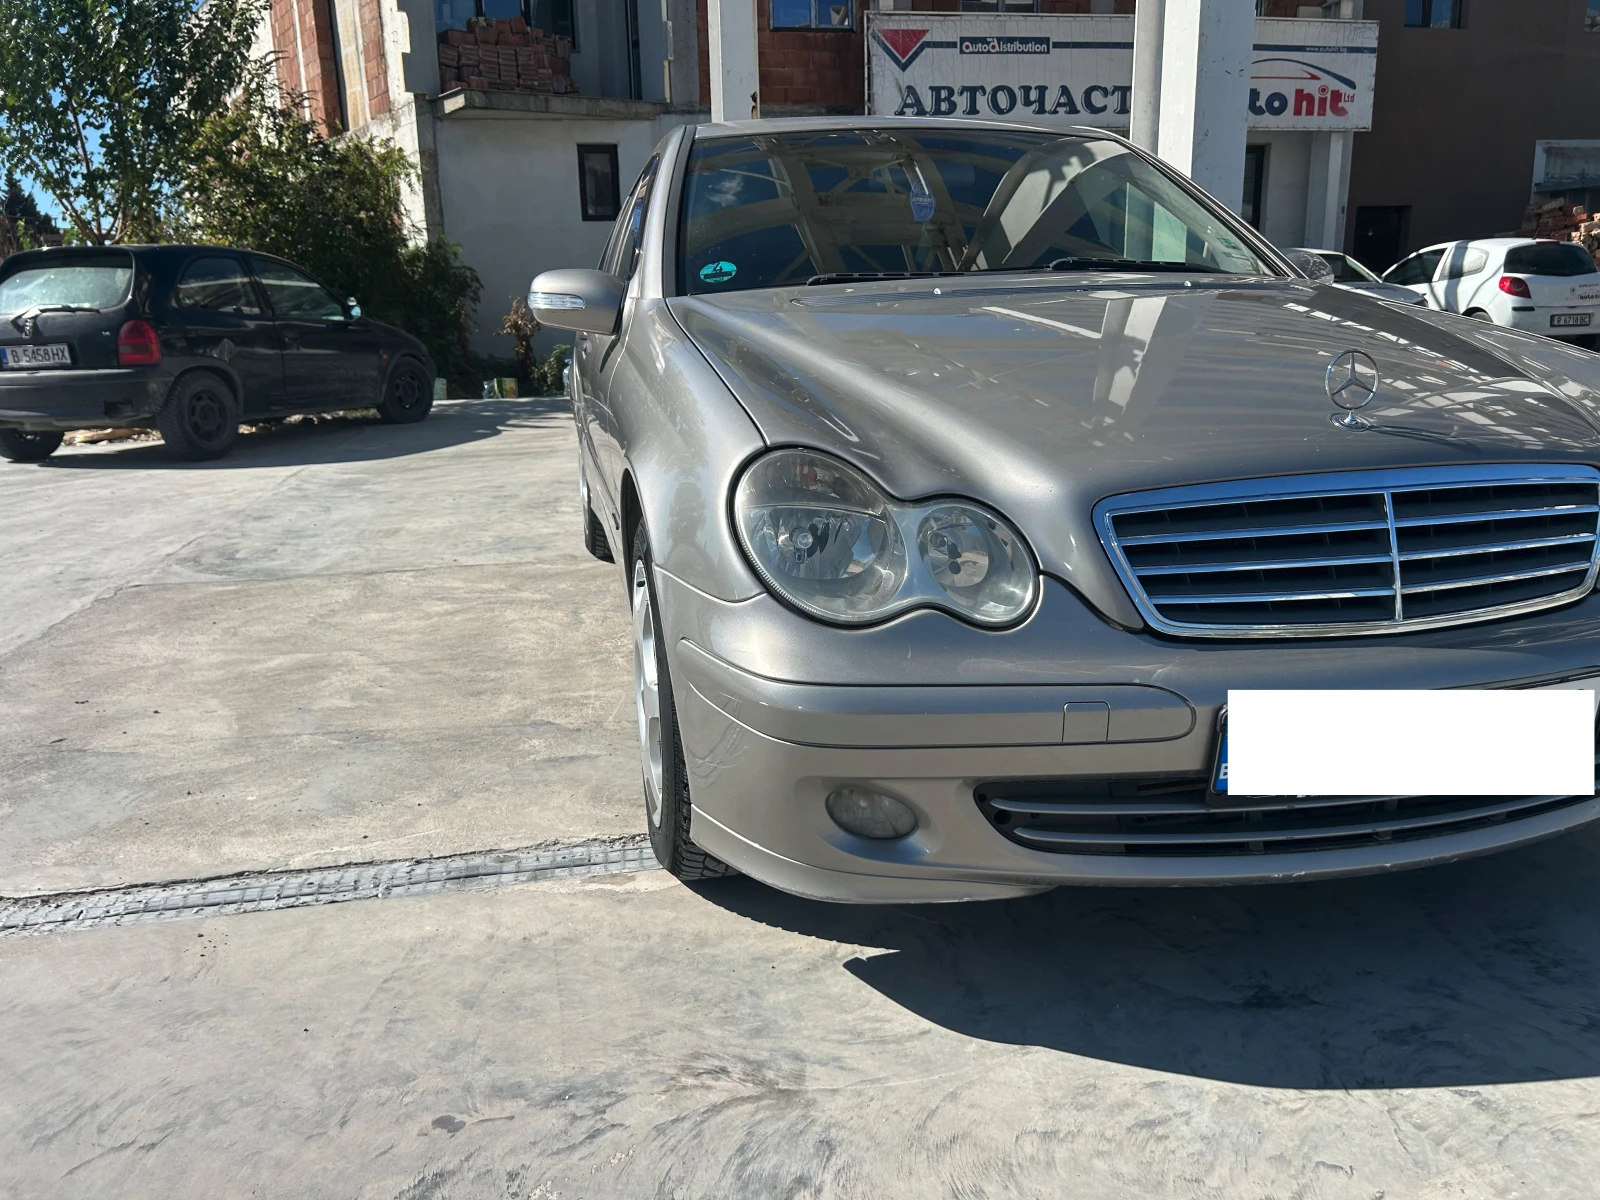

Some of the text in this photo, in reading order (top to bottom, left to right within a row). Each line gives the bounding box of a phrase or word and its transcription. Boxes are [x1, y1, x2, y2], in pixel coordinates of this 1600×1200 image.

[894, 84, 1132, 116] АВТОЧАСТ
[1343, 92, 1355, 103] Ltd
[51, 347, 68, 361] HX
